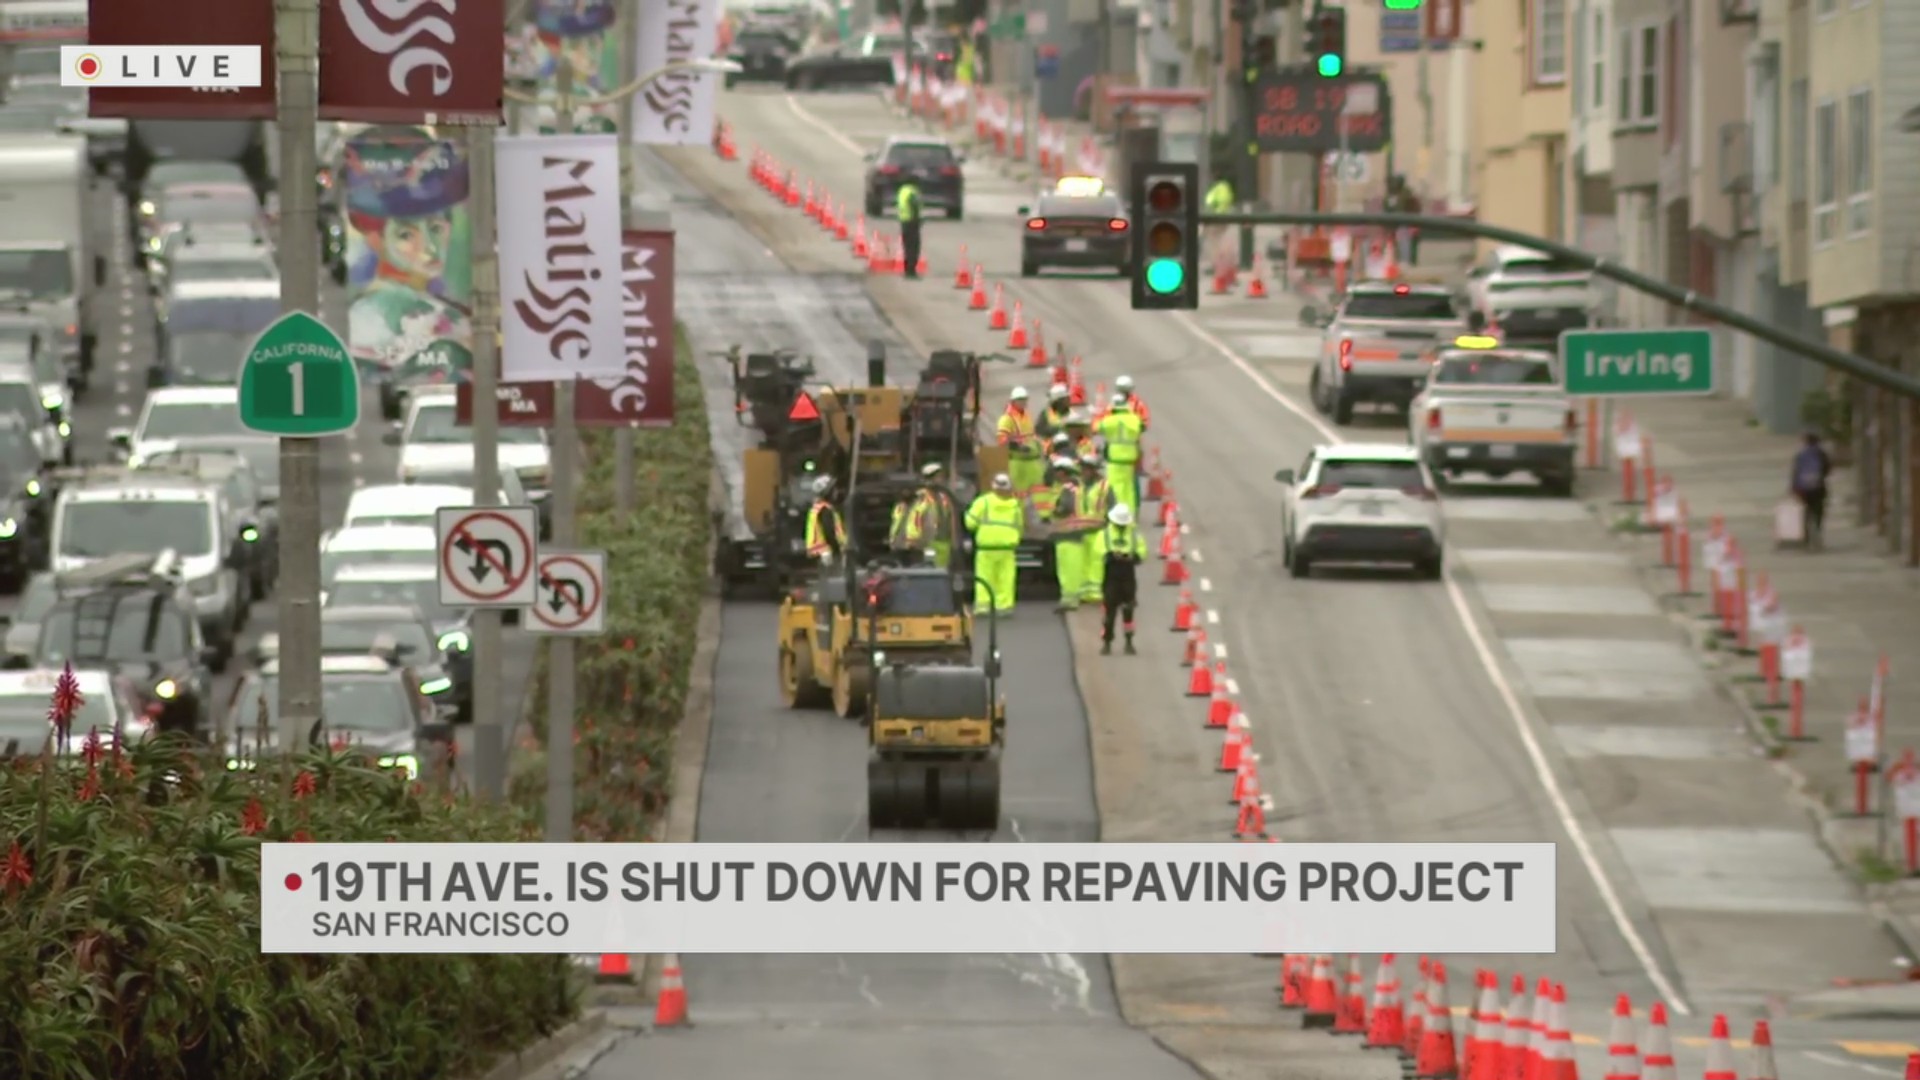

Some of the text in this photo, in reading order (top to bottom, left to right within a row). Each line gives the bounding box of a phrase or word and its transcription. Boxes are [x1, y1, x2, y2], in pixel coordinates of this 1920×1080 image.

[1256, 112, 1321, 137] ROAD
[512, 156, 602, 361] Matisse
[252, 342, 344, 363] CALIFORNIA
[1584, 349, 1693, 382] Irving
[287, 361, 304, 416] 1
